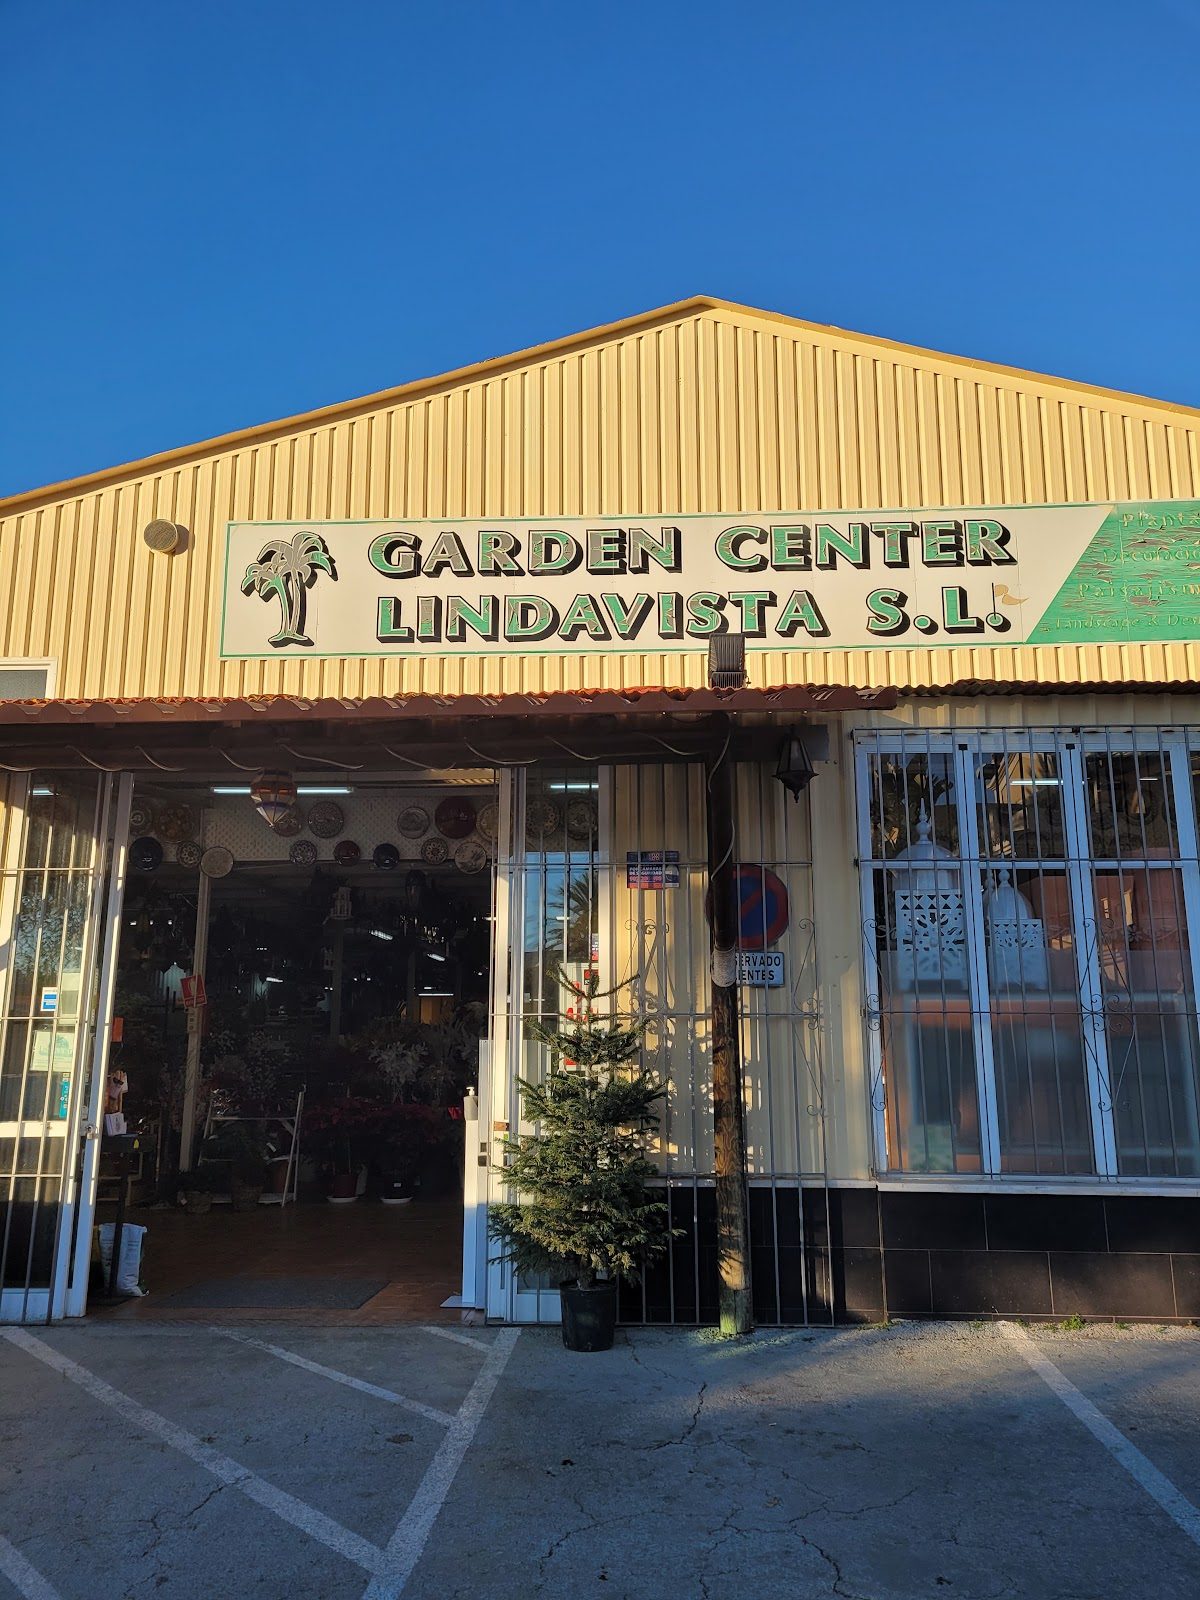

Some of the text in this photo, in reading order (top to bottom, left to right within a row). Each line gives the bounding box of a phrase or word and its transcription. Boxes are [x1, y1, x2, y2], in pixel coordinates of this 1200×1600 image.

[368, 519, 1018, 579] GARDEN CENTER
[376, 585, 1011, 643] LINDAVISTA S.L.
[735, 955, 781, 967] ERVADO
[735, 970, 775, 981] IENTES
